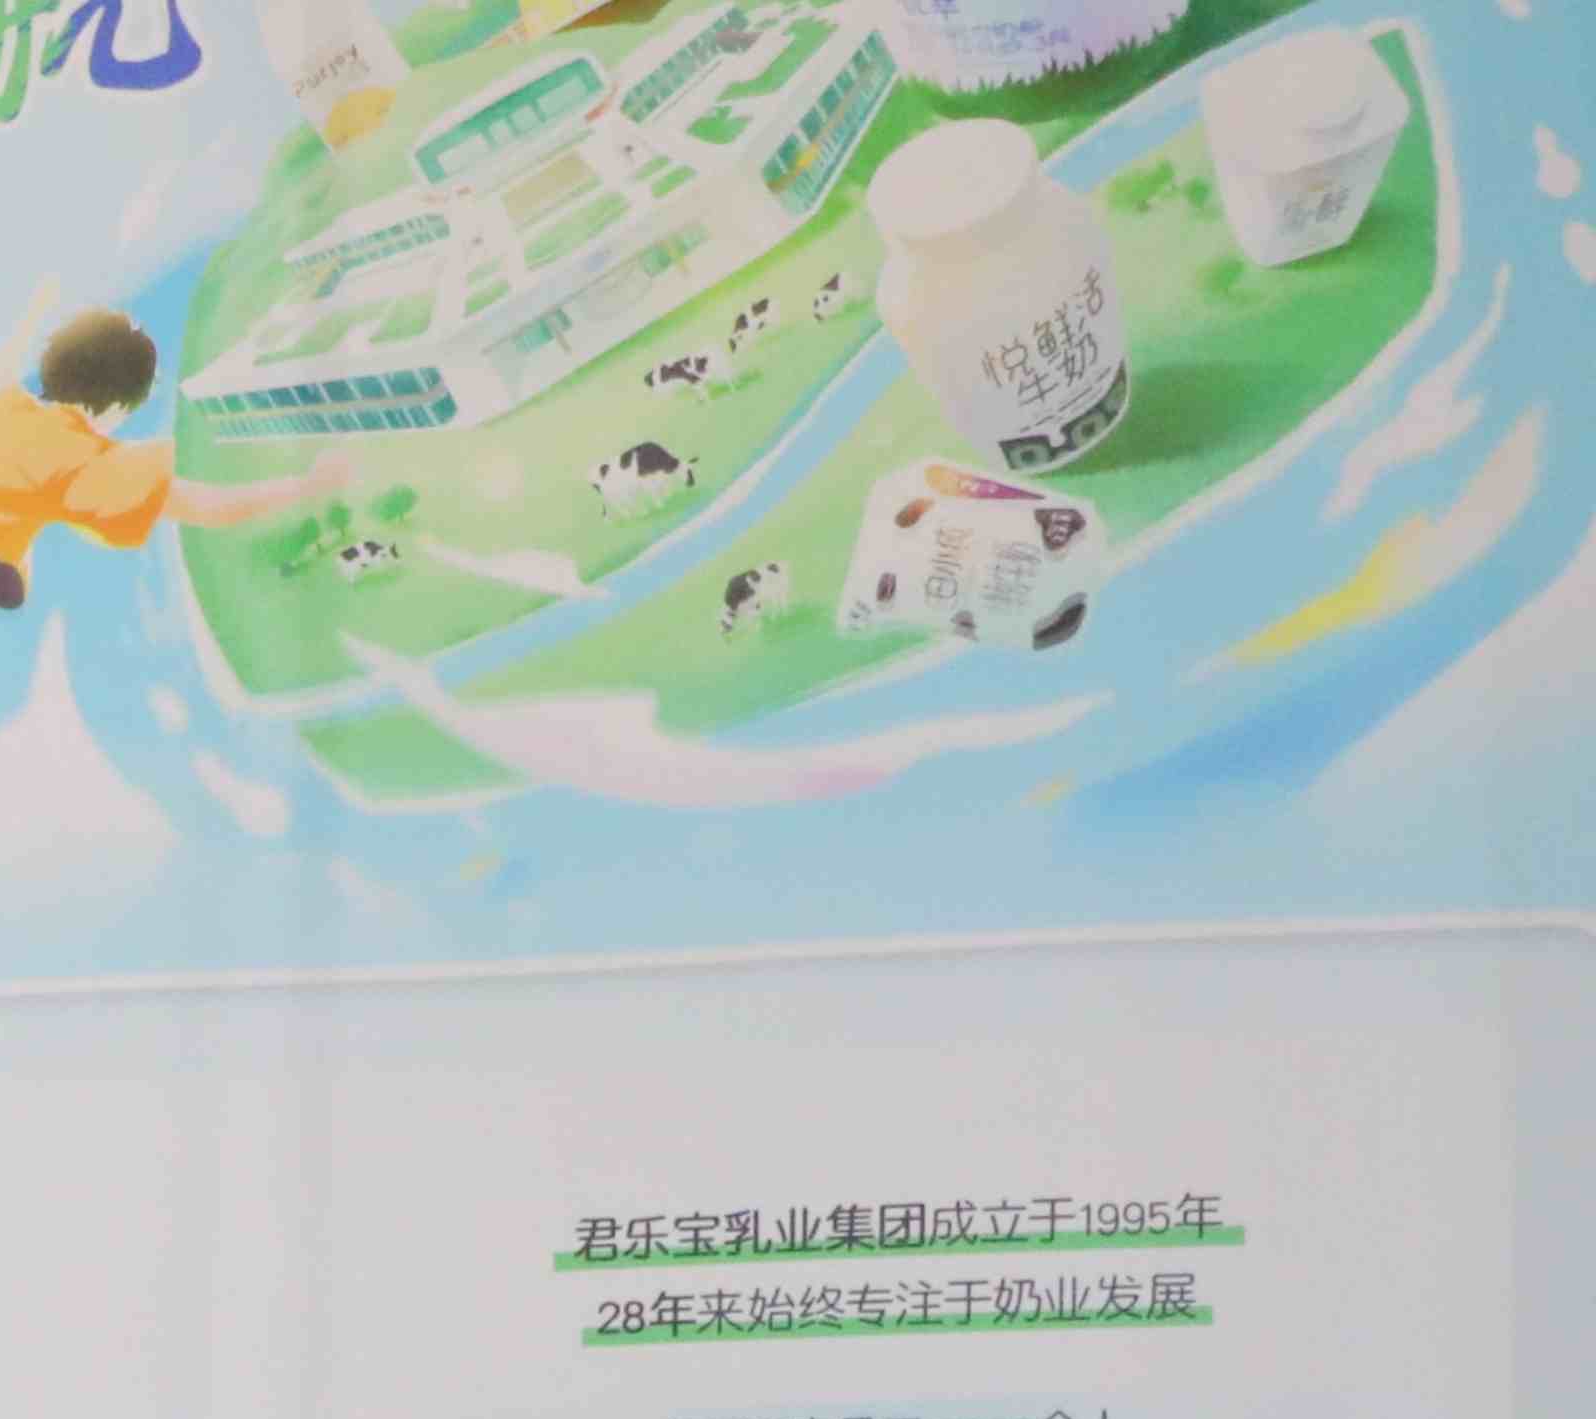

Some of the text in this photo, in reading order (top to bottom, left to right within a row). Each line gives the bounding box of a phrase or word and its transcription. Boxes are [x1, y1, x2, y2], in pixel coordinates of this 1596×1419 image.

[574, 1192, 1224, 1262] 君乐宝乳业集团成立于1995年
[596, 1272, 1196, 1337] 28年来始终专注于奶业发展
